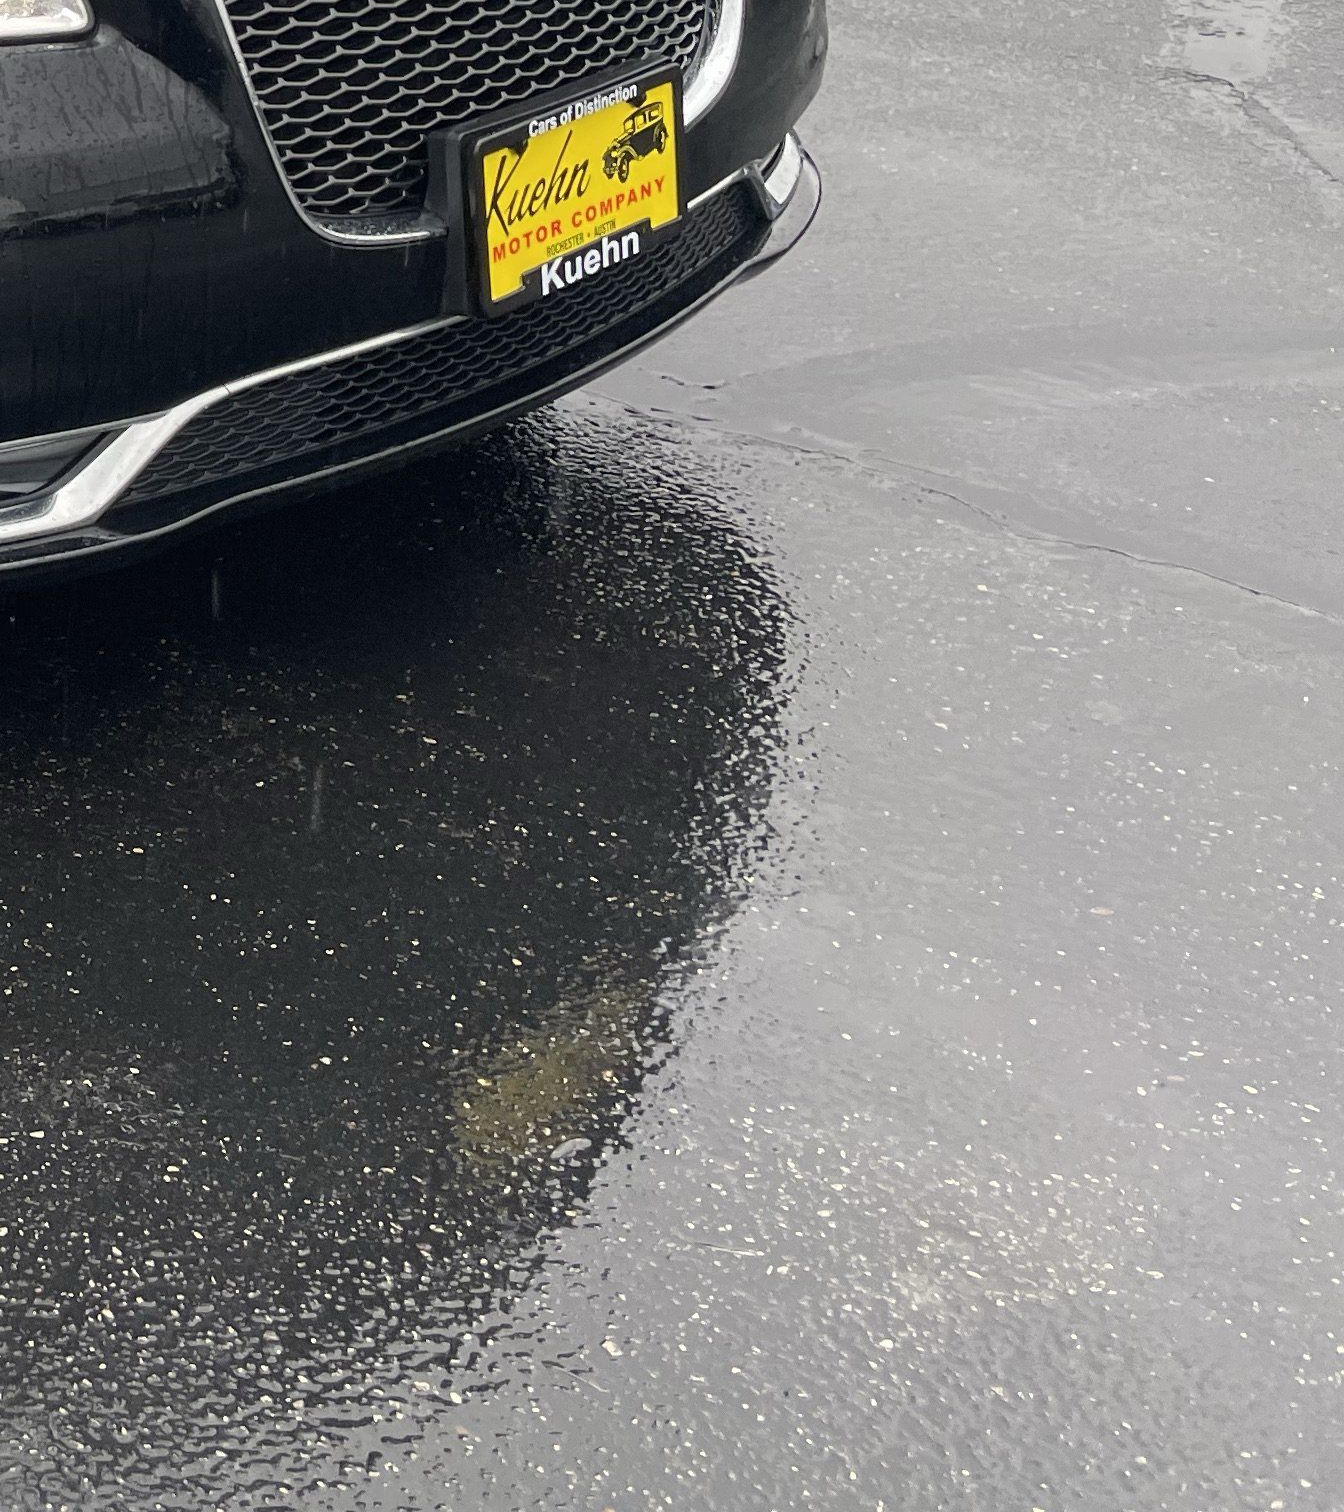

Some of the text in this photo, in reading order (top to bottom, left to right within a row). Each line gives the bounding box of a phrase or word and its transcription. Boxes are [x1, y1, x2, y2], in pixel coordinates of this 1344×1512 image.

[528, 83, 638, 137] Cars of Distinction
[486, 129, 591, 236] Kuehn
[493, 175, 665, 264] MOTOR COMPANY
[540, 231, 640, 296] Kuehn
